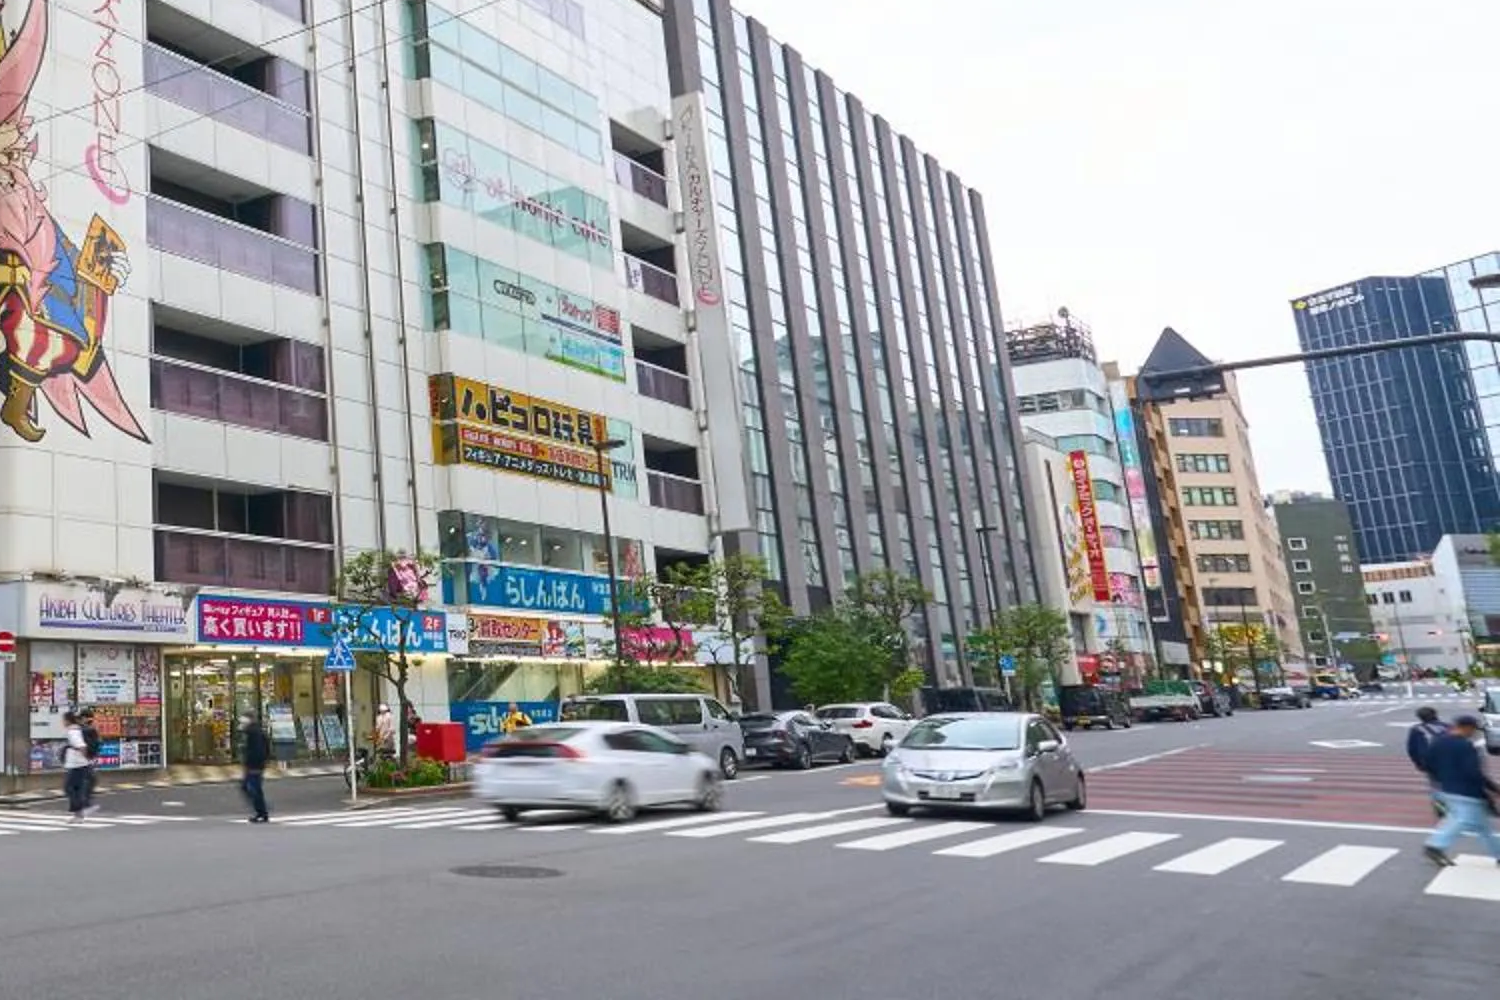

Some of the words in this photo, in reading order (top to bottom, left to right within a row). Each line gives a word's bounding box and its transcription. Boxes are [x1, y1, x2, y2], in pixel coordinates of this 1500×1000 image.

[91, 20, 122, 176] ZONE
[505, 576, 586, 610] らしんばん
